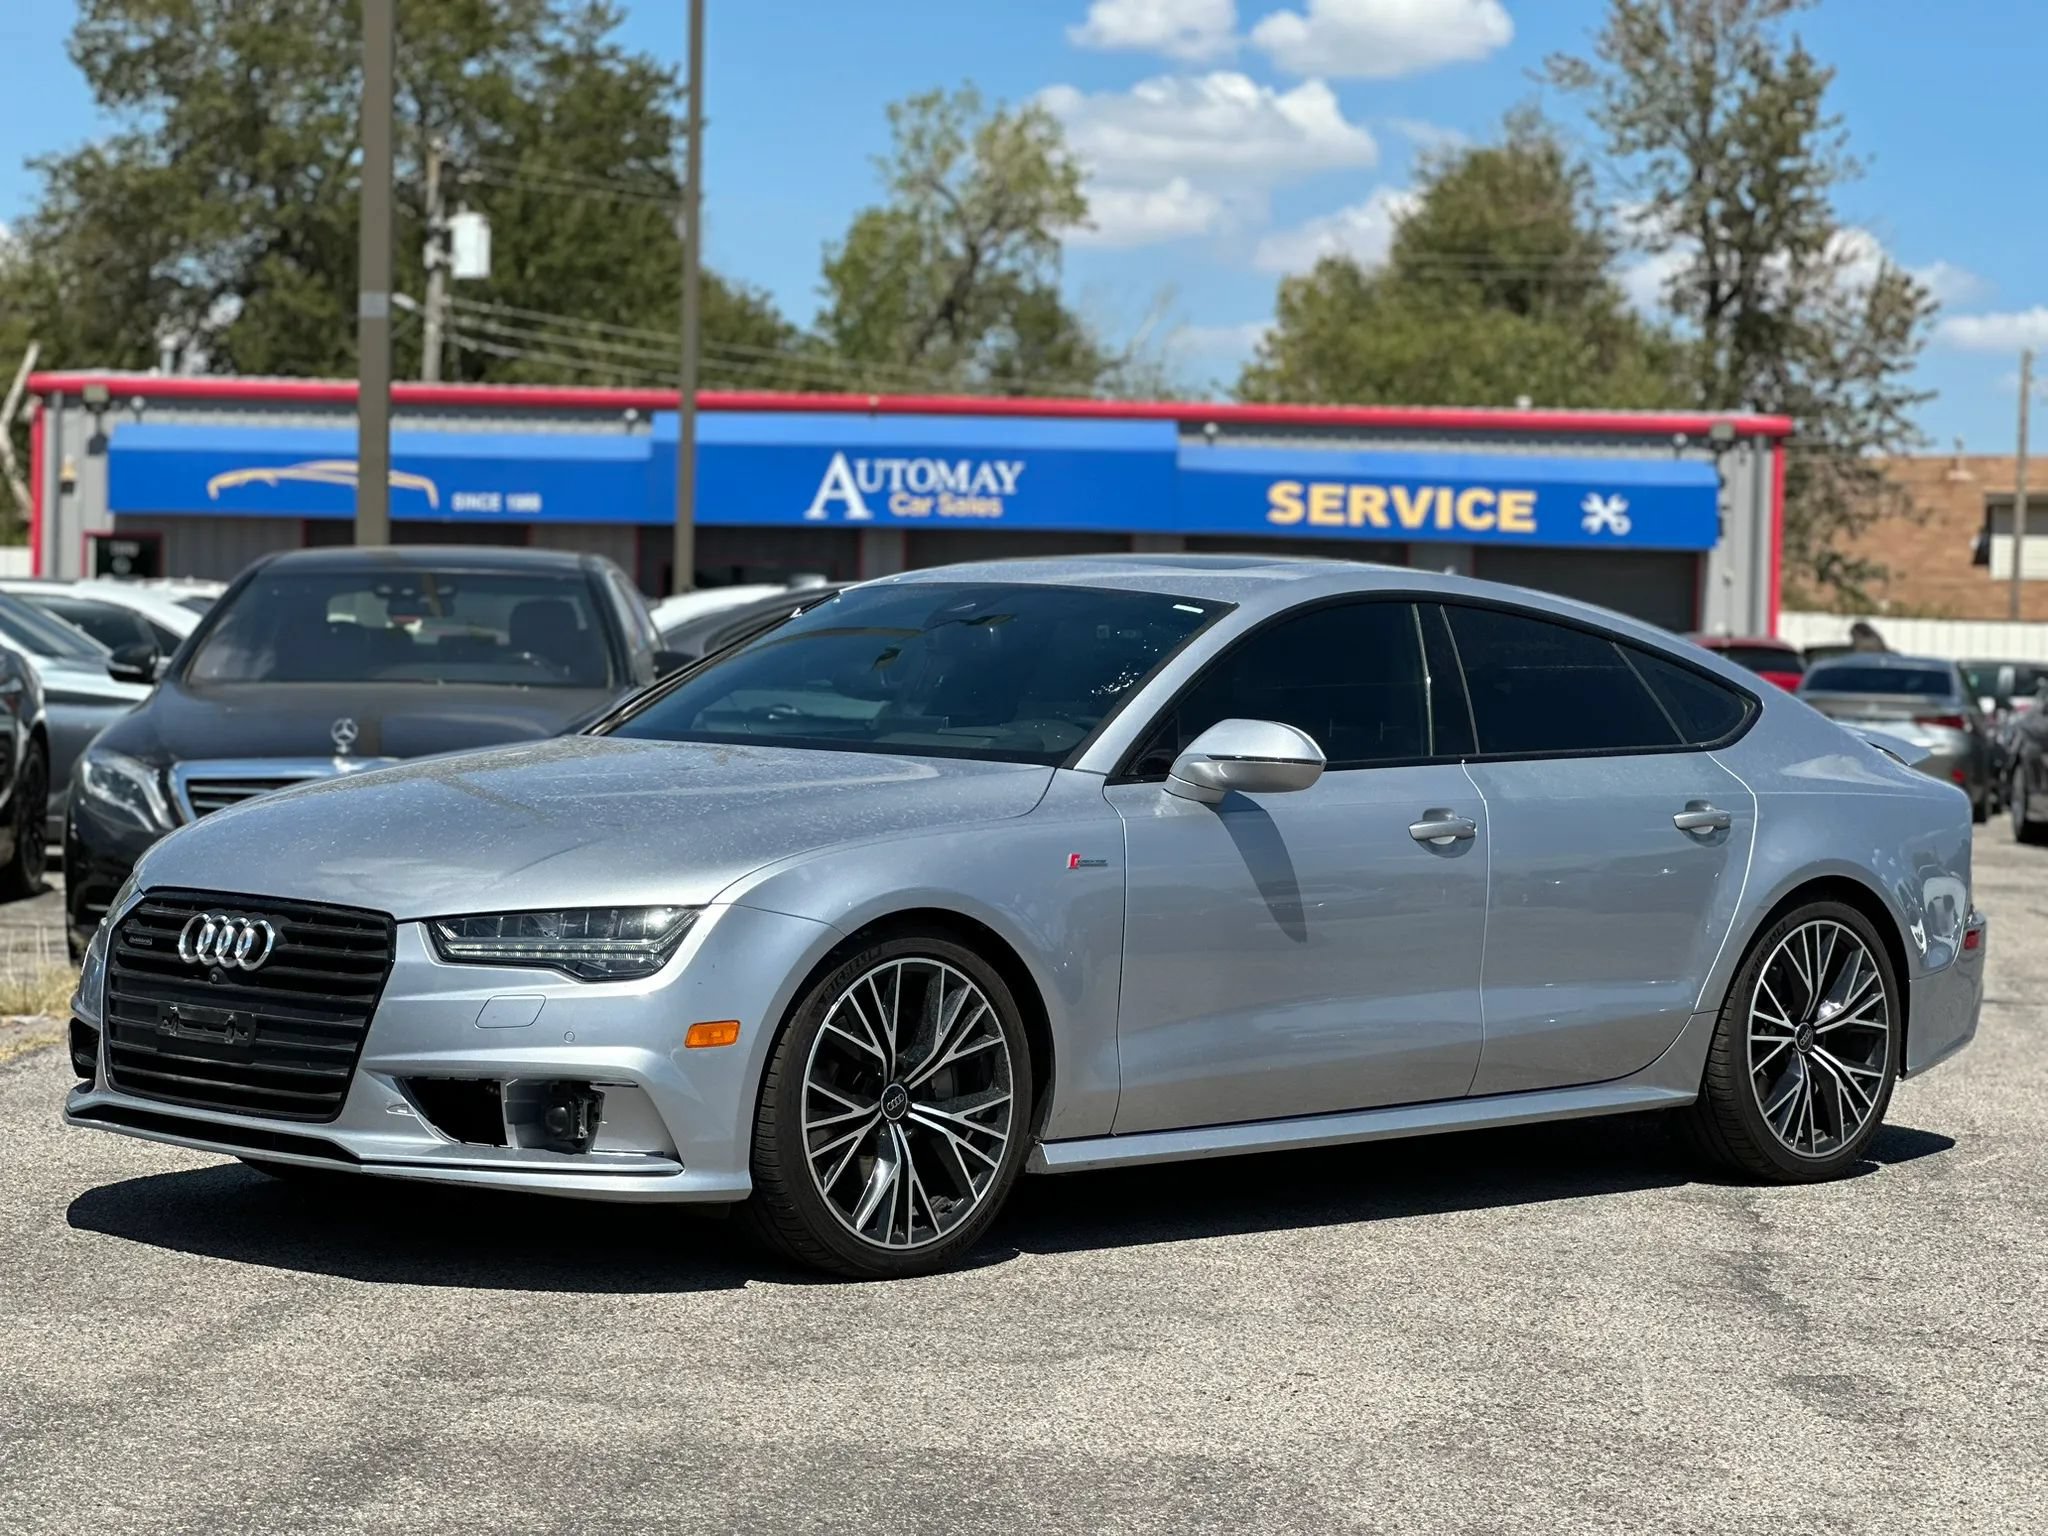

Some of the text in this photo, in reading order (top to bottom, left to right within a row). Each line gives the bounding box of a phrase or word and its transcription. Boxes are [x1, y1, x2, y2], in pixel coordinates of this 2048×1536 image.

[451, 491, 502, 513] SINCE
[803, 451, 1025, 520] AUTOMAY
[888, 491, 1004, 519] Car Sales
[1266, 480, 1537, 533] SERVICE
